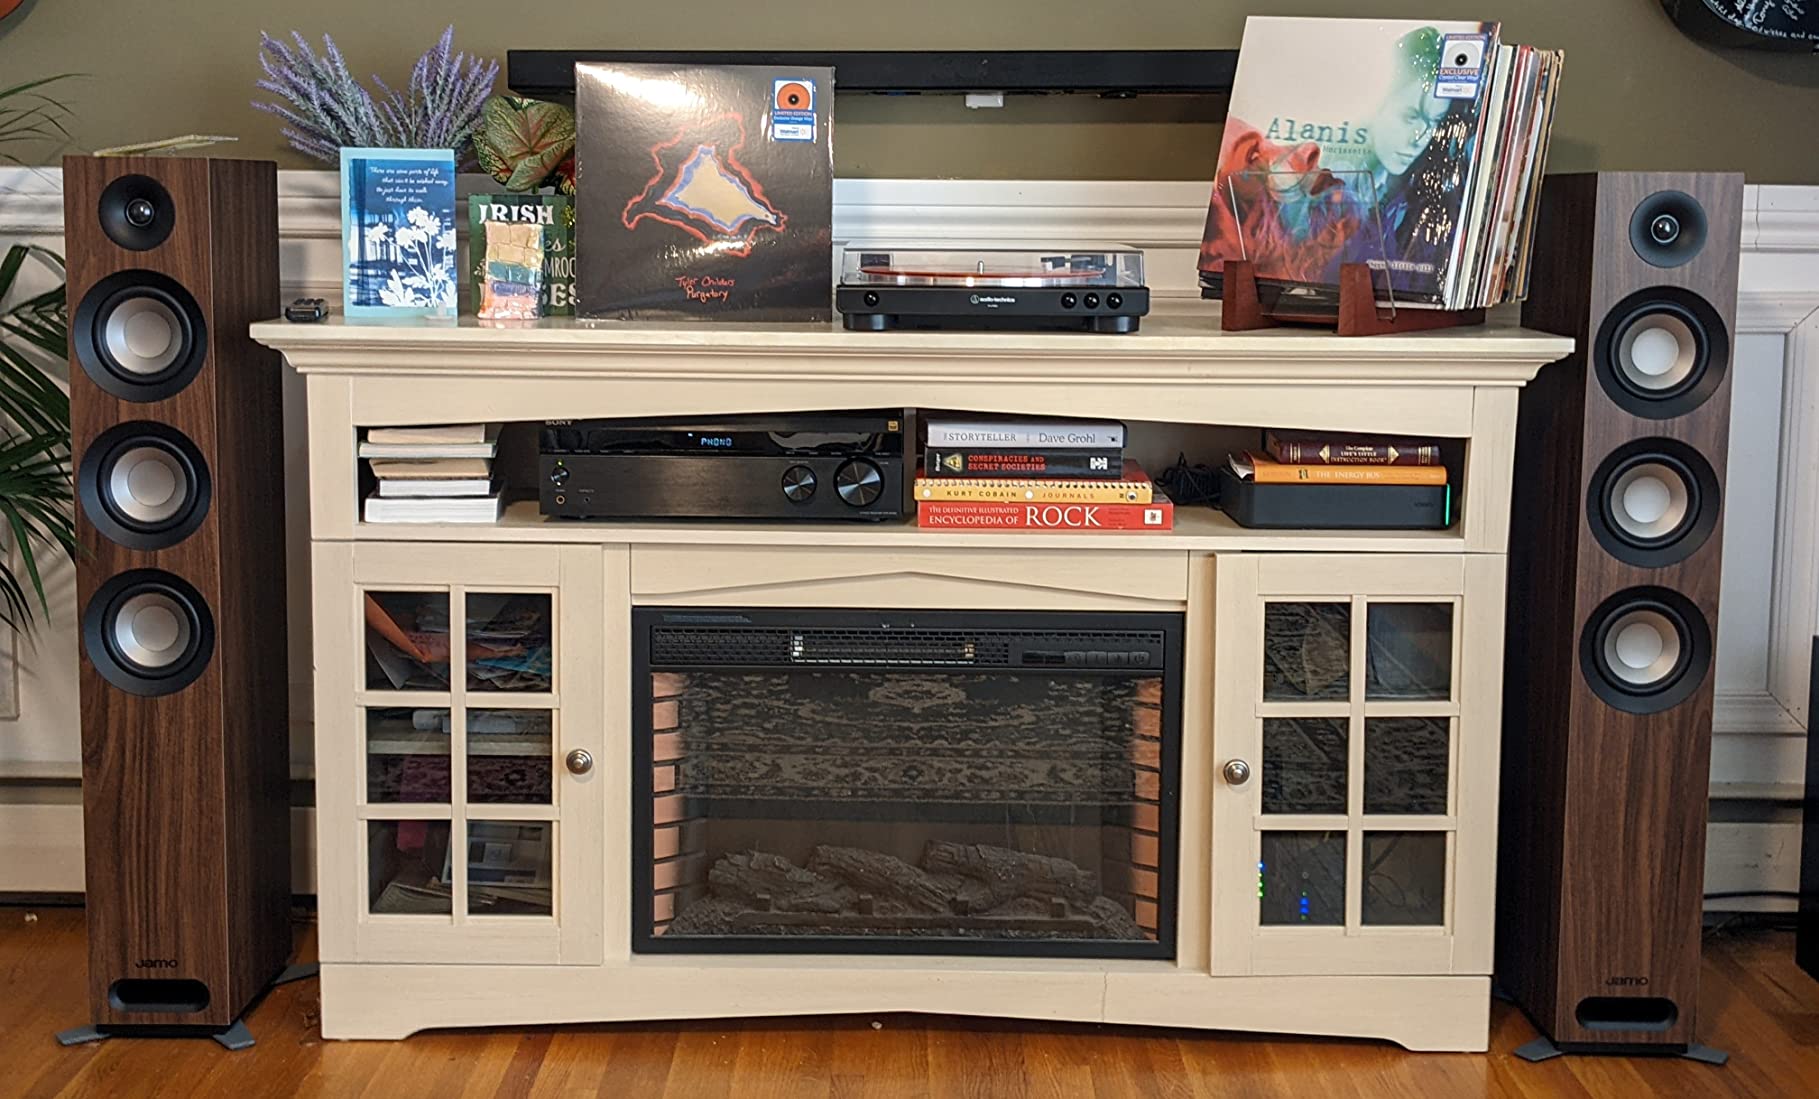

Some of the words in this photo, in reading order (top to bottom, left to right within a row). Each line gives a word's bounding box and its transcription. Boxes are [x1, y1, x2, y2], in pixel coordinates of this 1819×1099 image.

[1265, 117, 1368, 145] Alanis
[478, 203, 555, 225] IRISH
[675, 275, 699, 290] Tyler
[686, 285, 729, 304] Purgatory
[701, 437, 733, 447] PHONO
[949, 432, 1017, 442] STORYTELLER
[1038, 432, 1066, 443] Dave
[1067, 432, 1096, 444] Grohl
[967, 455, 1029, 463] CONSPIRACIES
[967, 463, 1000, 471] SECRET
[1001, 463, 1046, 471] SOCIETIES
[1334, 471, 1364, 480] ENERGY
[978, 490, 1017, 498] COBAIN
[929, 505, 942, 514] THE
[942, 506, 977, 514] DEFINITIVE
[978, 506, 1019, 514] ILLUSTRATED
[929, 515, 1003, 525] ENCYCLOPEDIA
[1005, 516, 1019, 525] OF
[1025, 505, 1102, 527] ROCK
